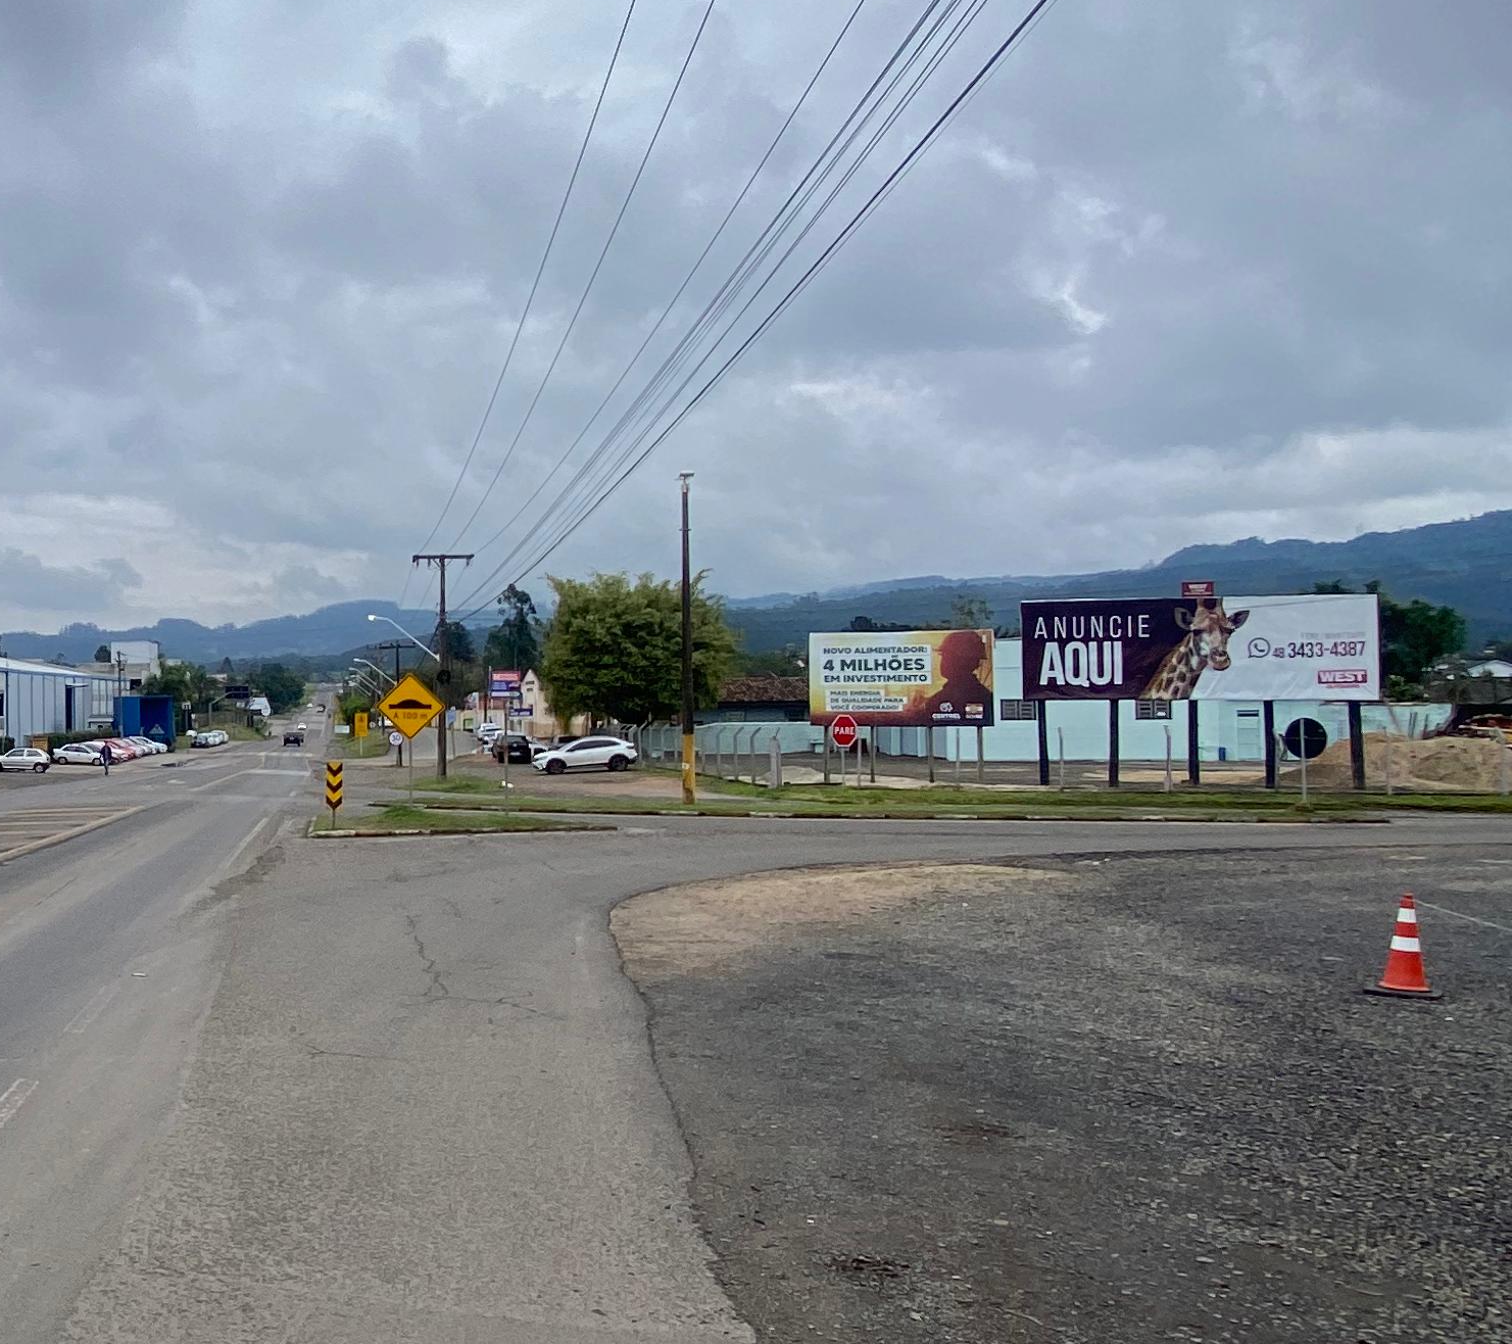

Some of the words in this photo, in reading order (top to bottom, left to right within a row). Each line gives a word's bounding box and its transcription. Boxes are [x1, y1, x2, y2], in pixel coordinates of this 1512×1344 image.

[1034, 614, 1151, 640] ANUNCIE
[823, 647, 852, 655] NOVO
[854, 646, 928, 654] ALIMENTADOR:
[1287, 640, 1366, 658] 3433-4387
[823, 659, 835, 671] 4
[840, 655, 925, 671] MILHÕES
[1039, 640, 1123, 688] AQUI
[824, 674, 841, 682] EM
[843, 674, 927, 682] INVESTIMENTO
[1318, 670, 1367, 683] WEST
[834, 726, 855, 735] PARE
